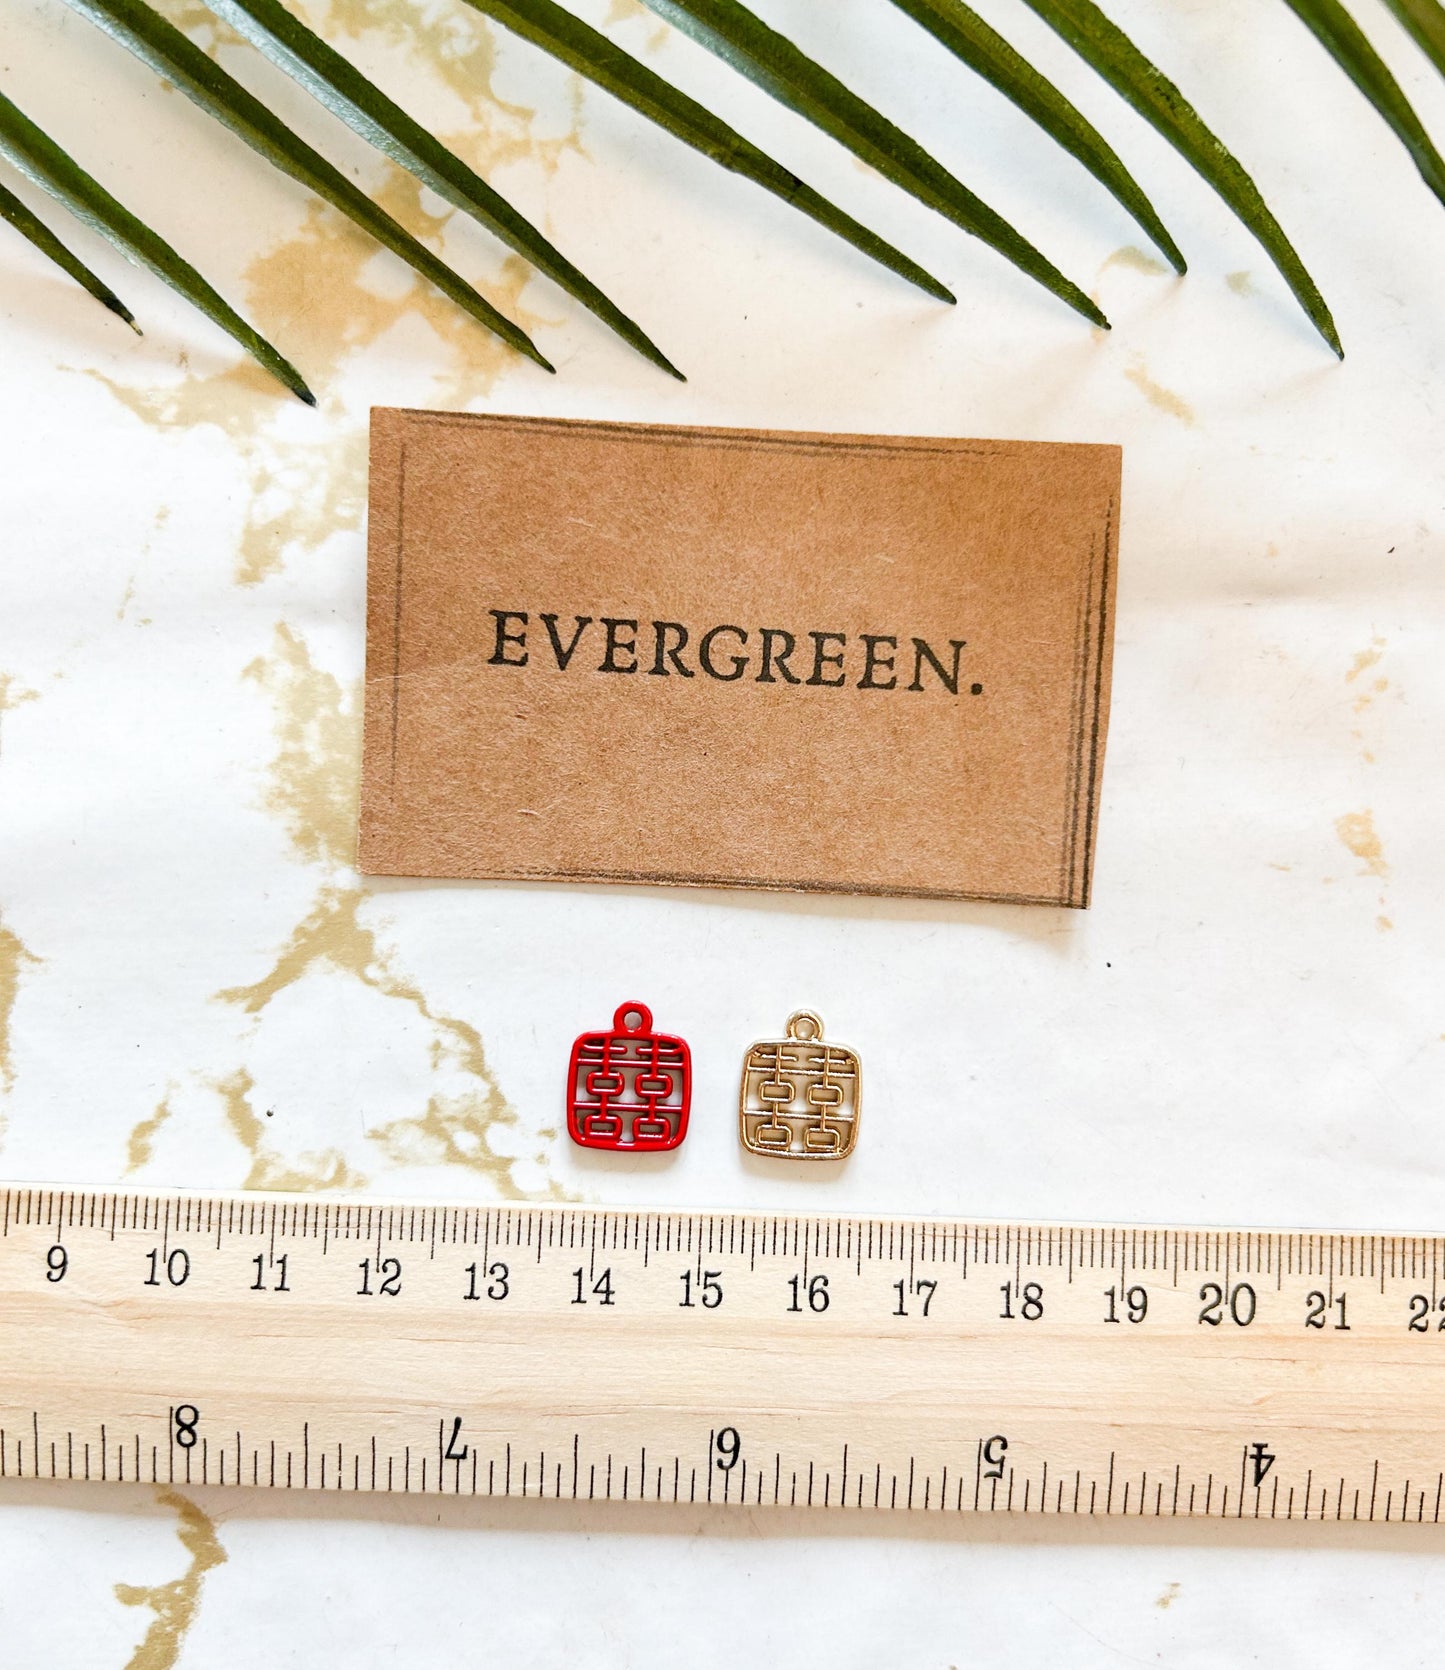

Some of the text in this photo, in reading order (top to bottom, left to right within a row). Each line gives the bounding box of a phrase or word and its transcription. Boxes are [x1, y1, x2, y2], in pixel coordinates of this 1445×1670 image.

[487, 609, 985, 696] EVERGREEN.
[46, 1245, 69, 1283] 9
[144, 1248, 191, 1286] 10
[250, 1253, 291, 1292] 11
[356, 1257, 403, 1297] 12
[463, 1261, 510, 1301] 13
[571, 1267, 616, 1306] 14
[679, 1270, 724, 1309] 15
[787, 1274, 830, 1313] 16
[893, 1279, 938, 1317] 17
[999, 1281, 1044, 1320] 18
[1103, 1285, 1149, 1324] 19
[1198, 1282, 1257, 1327] 20
[1305, 1290, 1351, 1331] 21
[175, 1404, 200, 1448] 8
[445, 1416, 468, 1460] 7
[983, 1435, 1008, 1479] 5
[1249, 1442, 1276, 1487] 4
